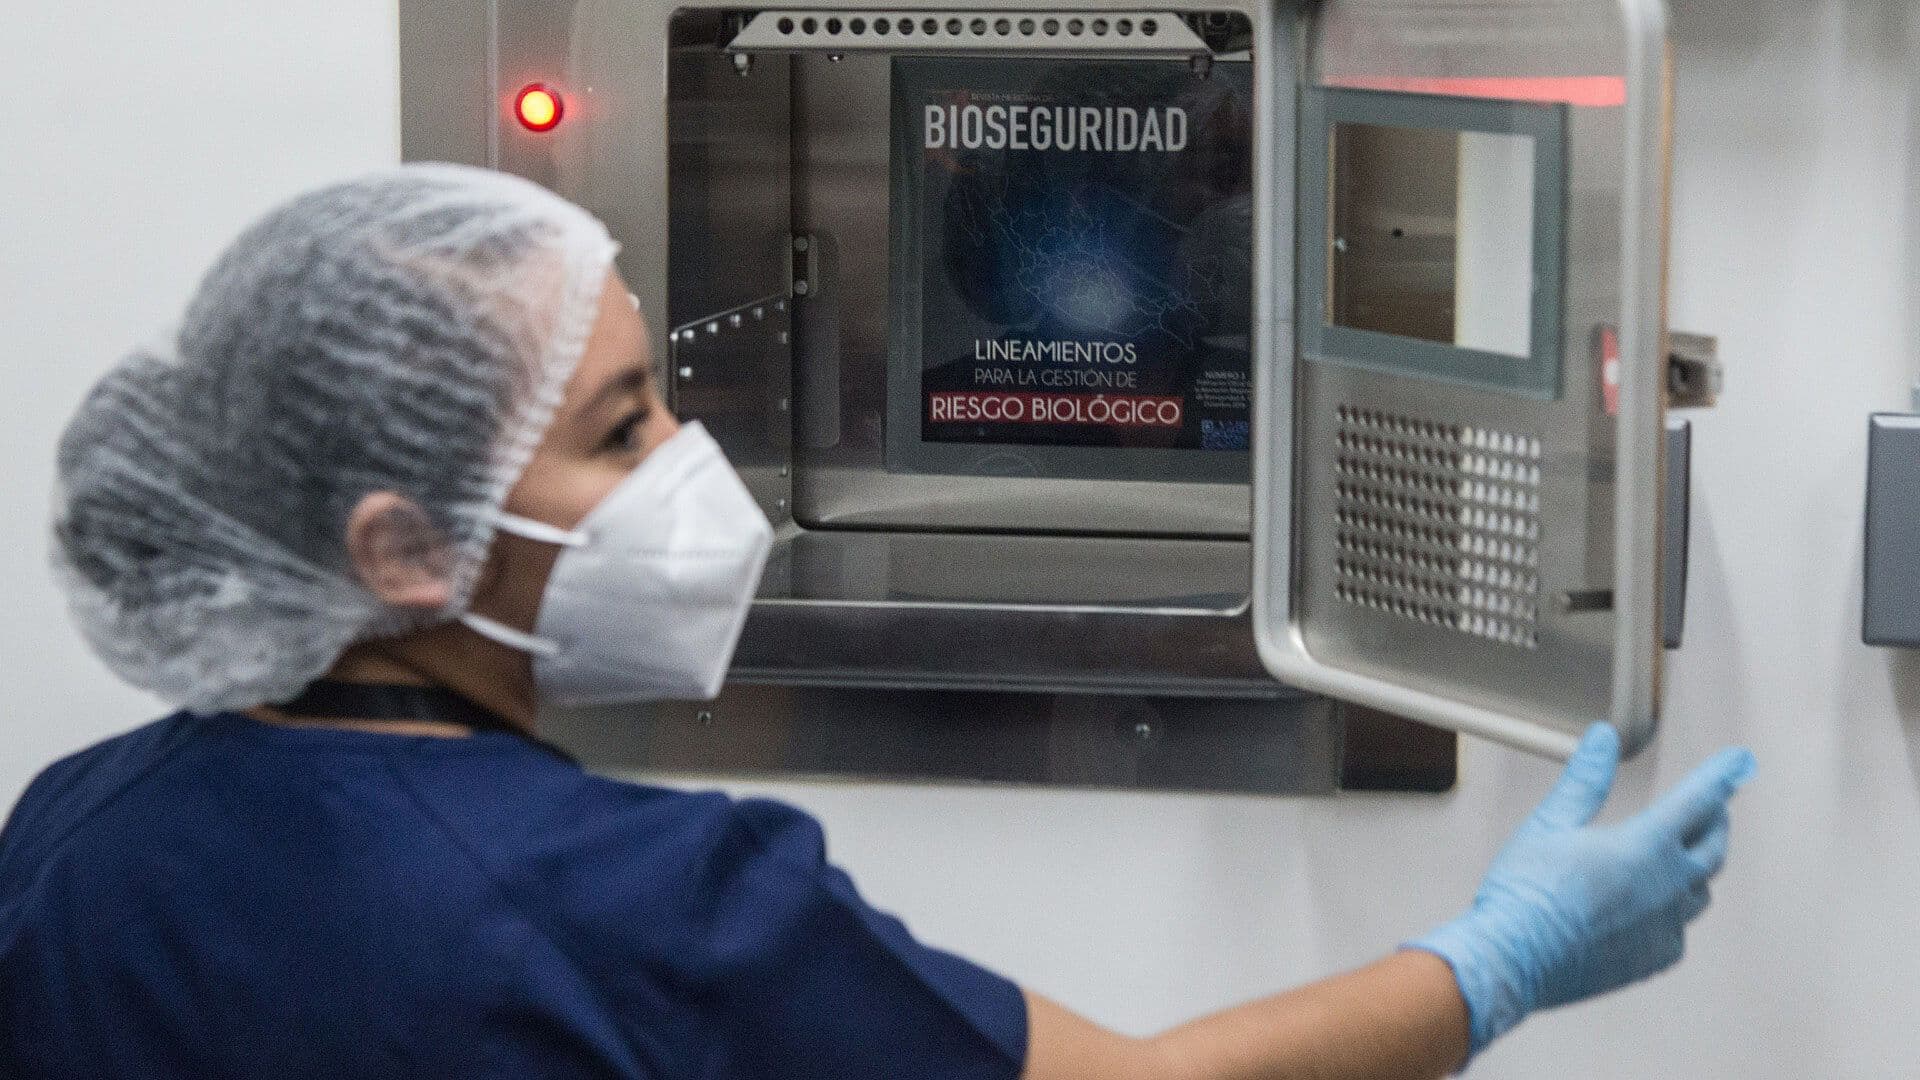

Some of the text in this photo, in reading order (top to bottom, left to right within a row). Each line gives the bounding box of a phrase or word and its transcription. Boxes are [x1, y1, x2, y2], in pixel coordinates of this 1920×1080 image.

[925, 104, 1188, 151] BIOSEGURIDAD
[975, 339, 1137, 364] LINEAMIENTOS
[975, 369, 1138, 388] PARA LA GESTIÓN DE
[931, 394, 1181, 424] RIESGO BIOLÓGICO
